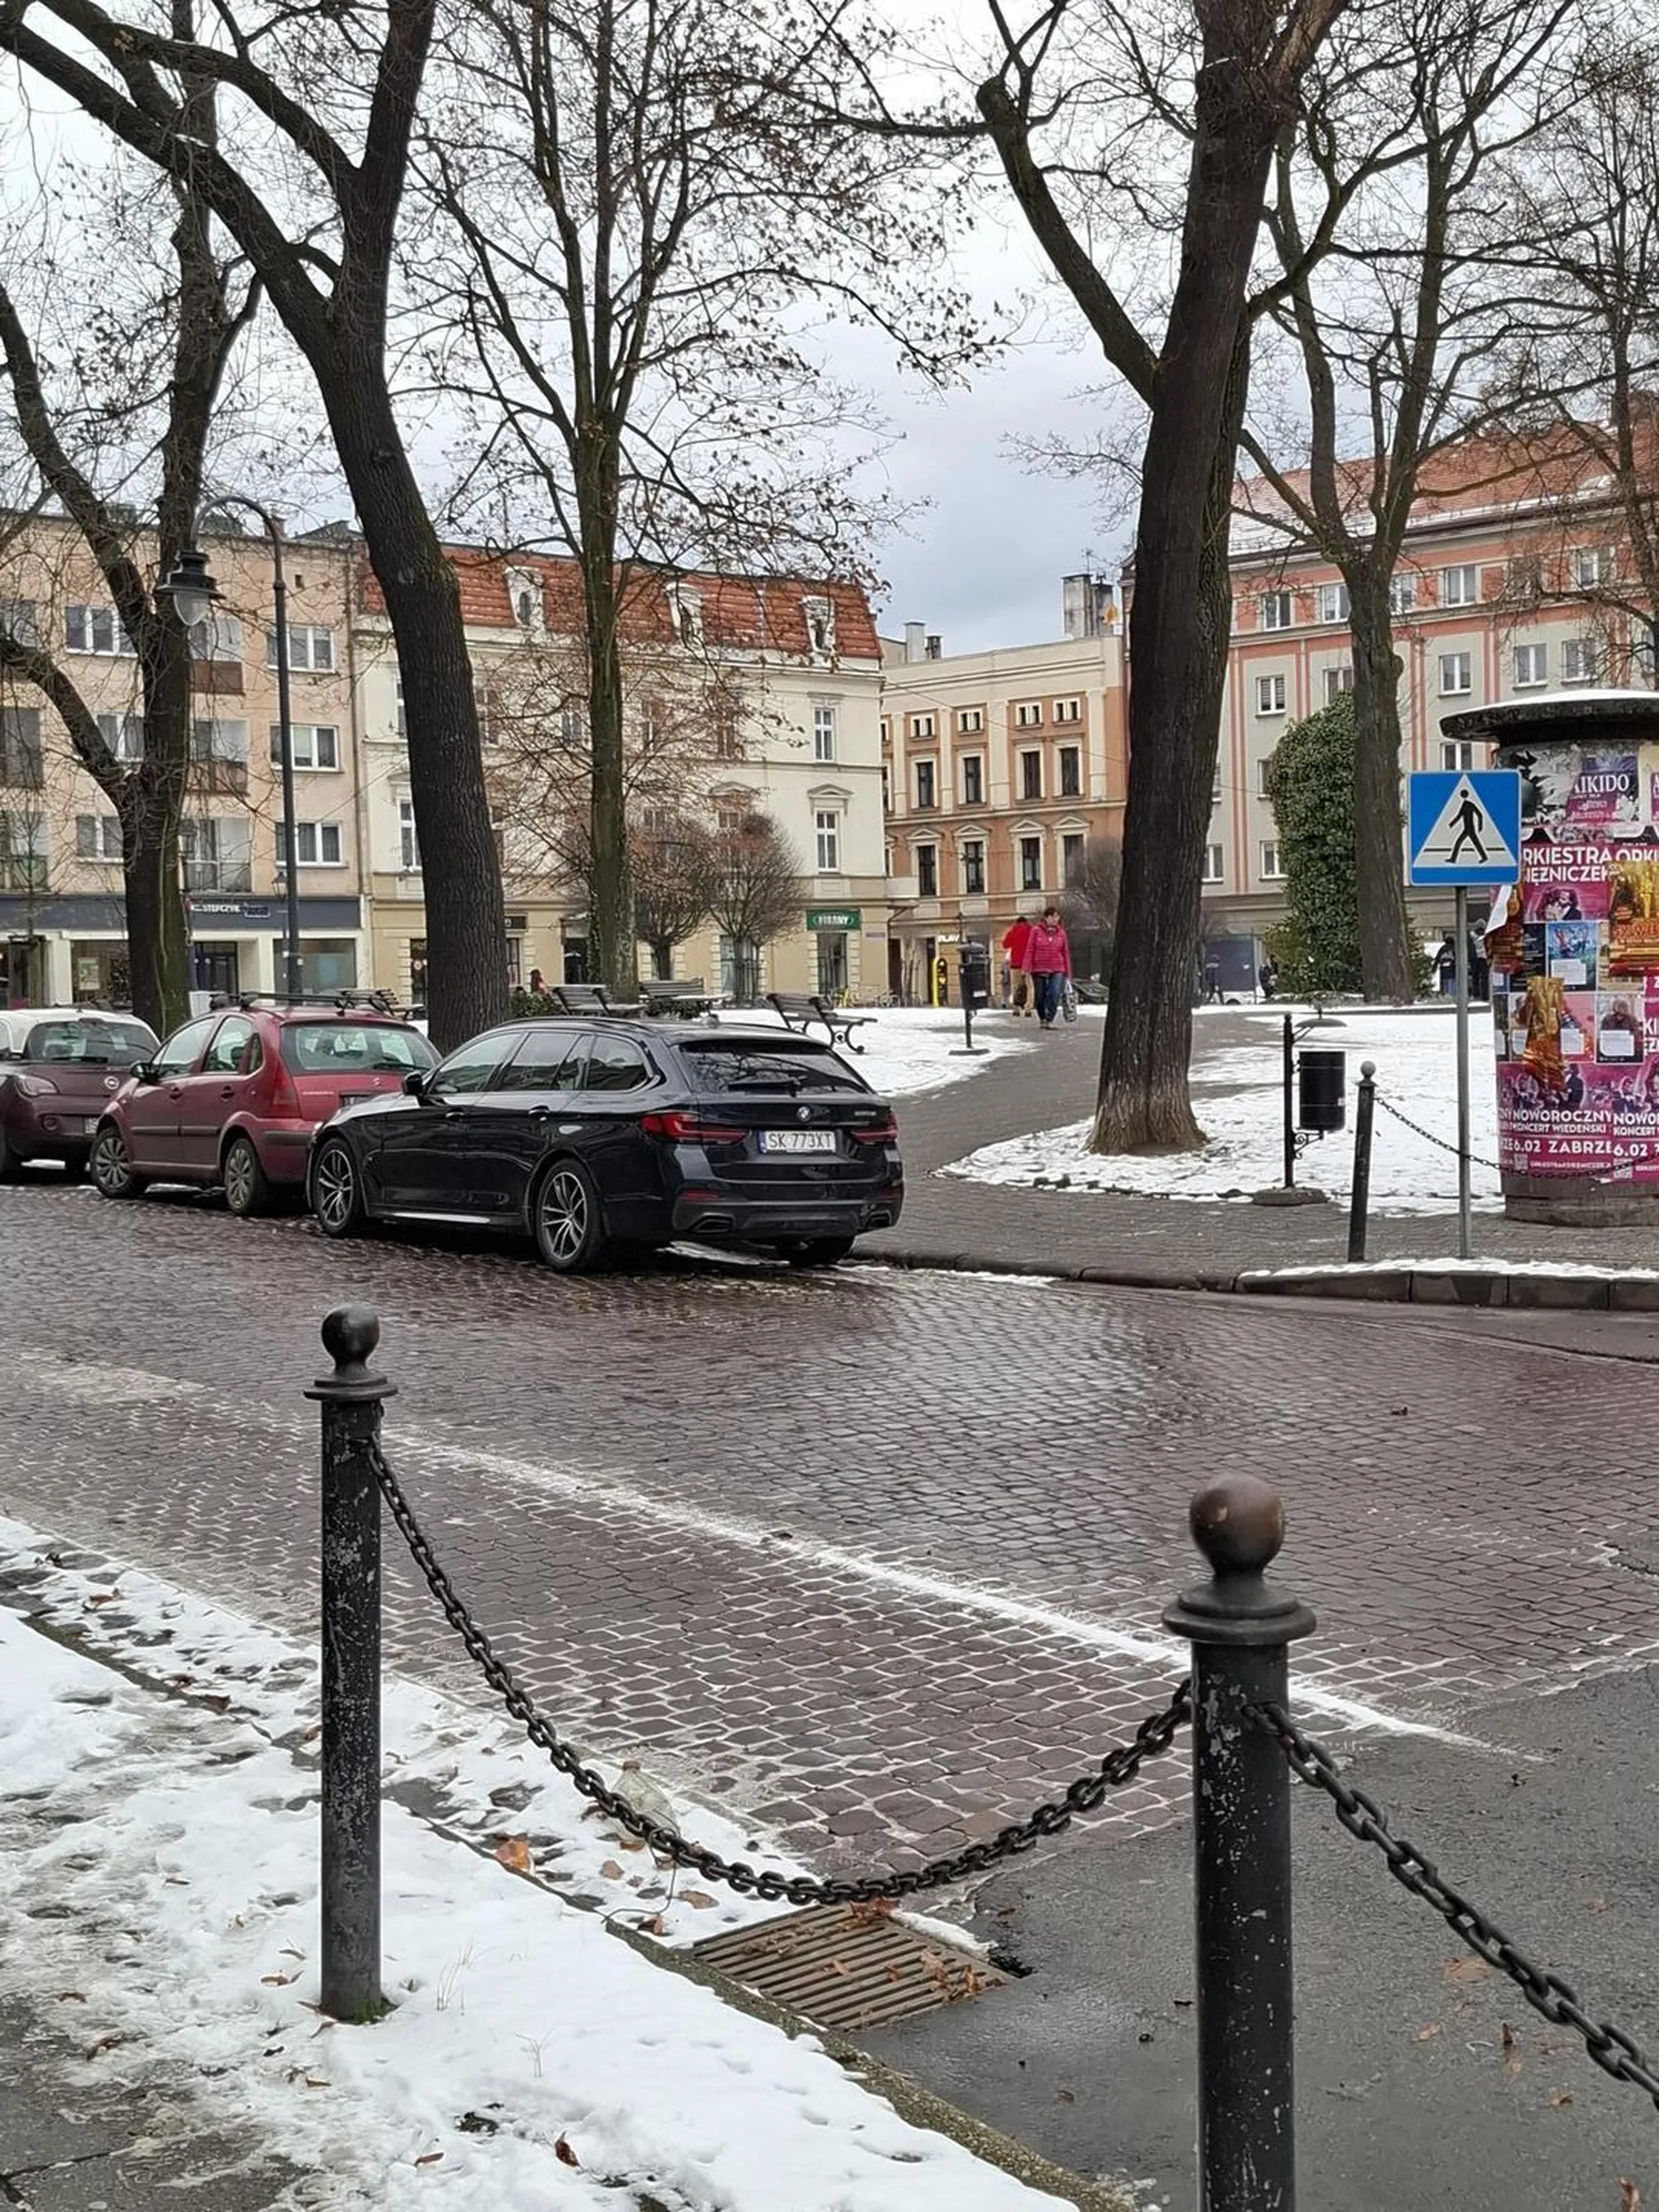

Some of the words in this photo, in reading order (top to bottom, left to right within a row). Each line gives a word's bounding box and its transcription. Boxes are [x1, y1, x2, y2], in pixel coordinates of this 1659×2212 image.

[1514, 1109, 1613, 1123] NOWOROCZNY
[1614, 1113, 1659, 1125] NOWO
[1614, 1125, 1655, 1136] KONCERT
[769, 1133, 787, 1148] SK
[792, 1133, 832, 1148] 773XT
[1514, 1140, 1541, 1152] 6.02
[1548, 1141, 1612, 1154] ZABRZE
[1614, 1143, 1648, 1156] 6.02
